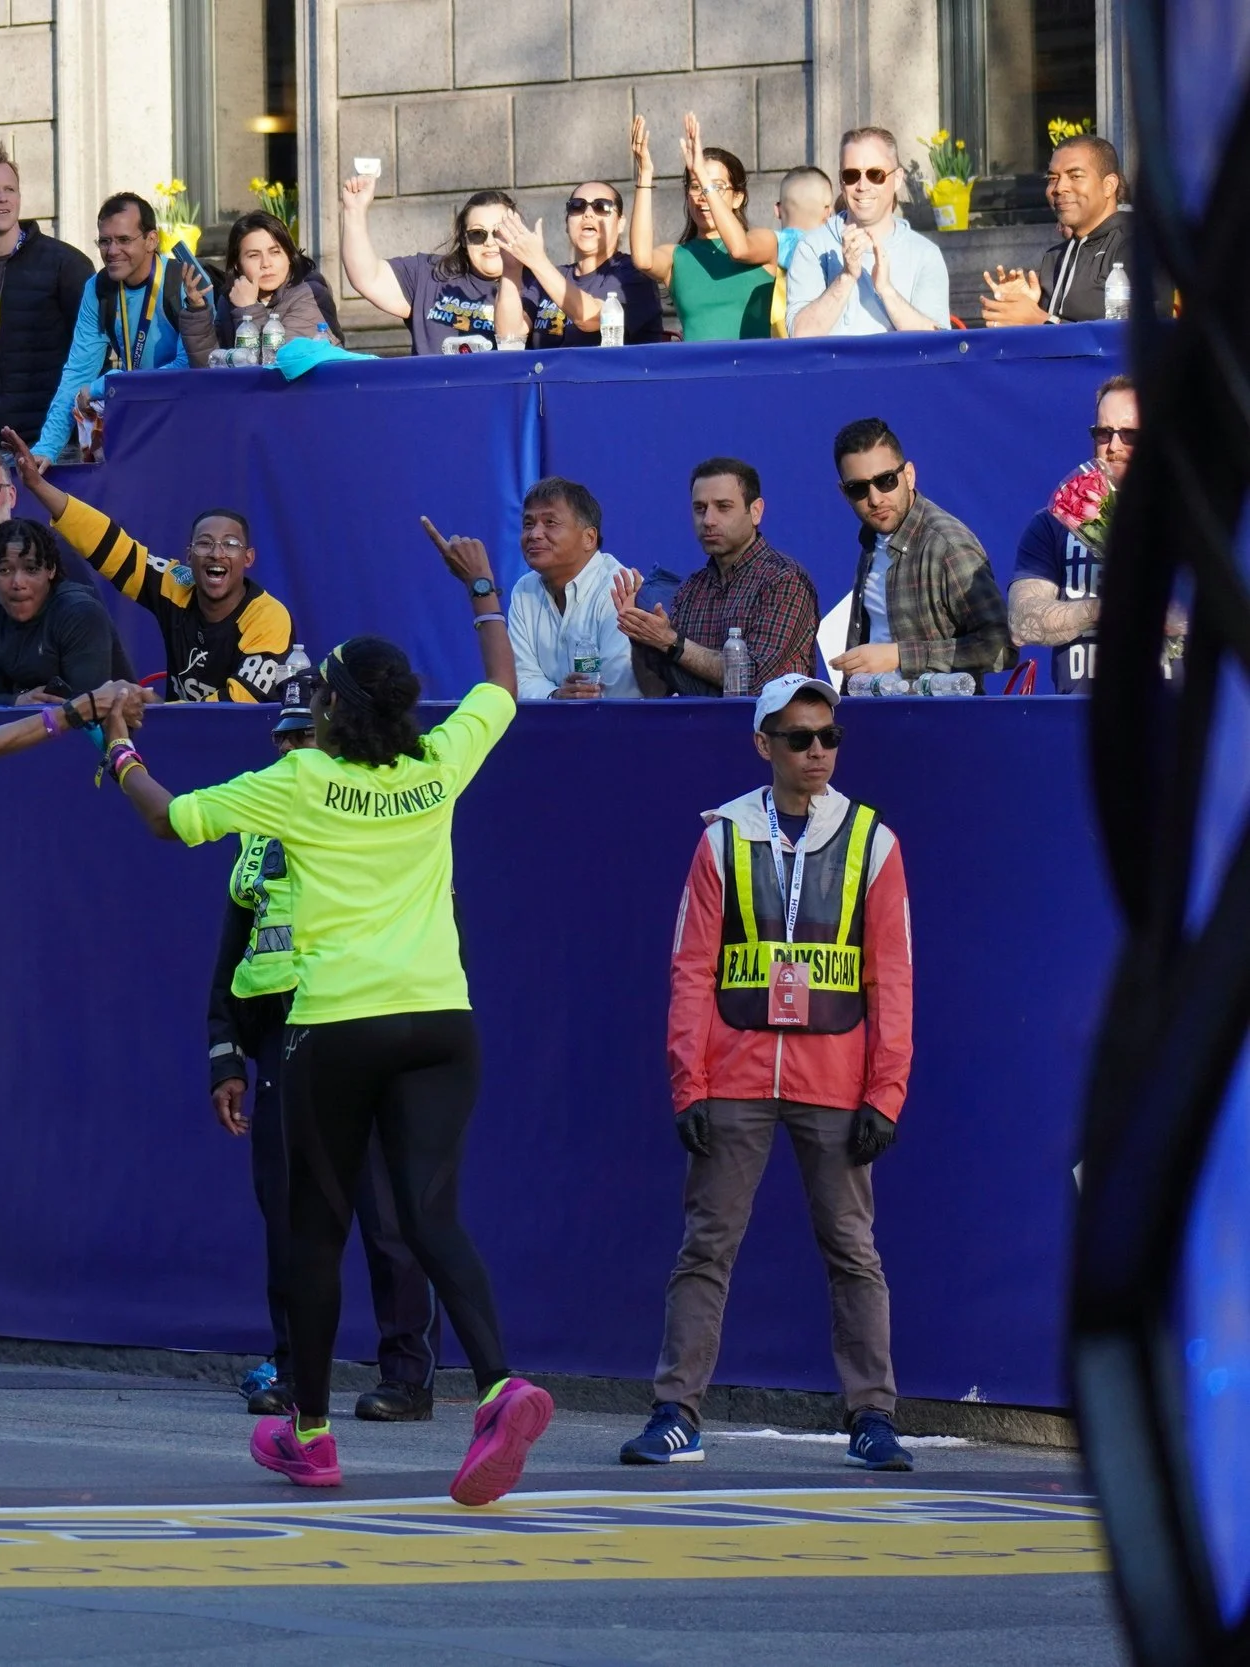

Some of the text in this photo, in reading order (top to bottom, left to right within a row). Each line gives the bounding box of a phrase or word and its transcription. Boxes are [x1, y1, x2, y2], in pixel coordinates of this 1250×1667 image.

[237, 655, 279, 694] 88
[324, 780, 448, 818] RUM RUNNER
[768, 808, 779, 838] FINISH
[788, 898, 799, 931] FINISH
[727, 947, 856, 987] B.A.A. SICIAN
[682, 1545, 1110, 1564] OSTON
